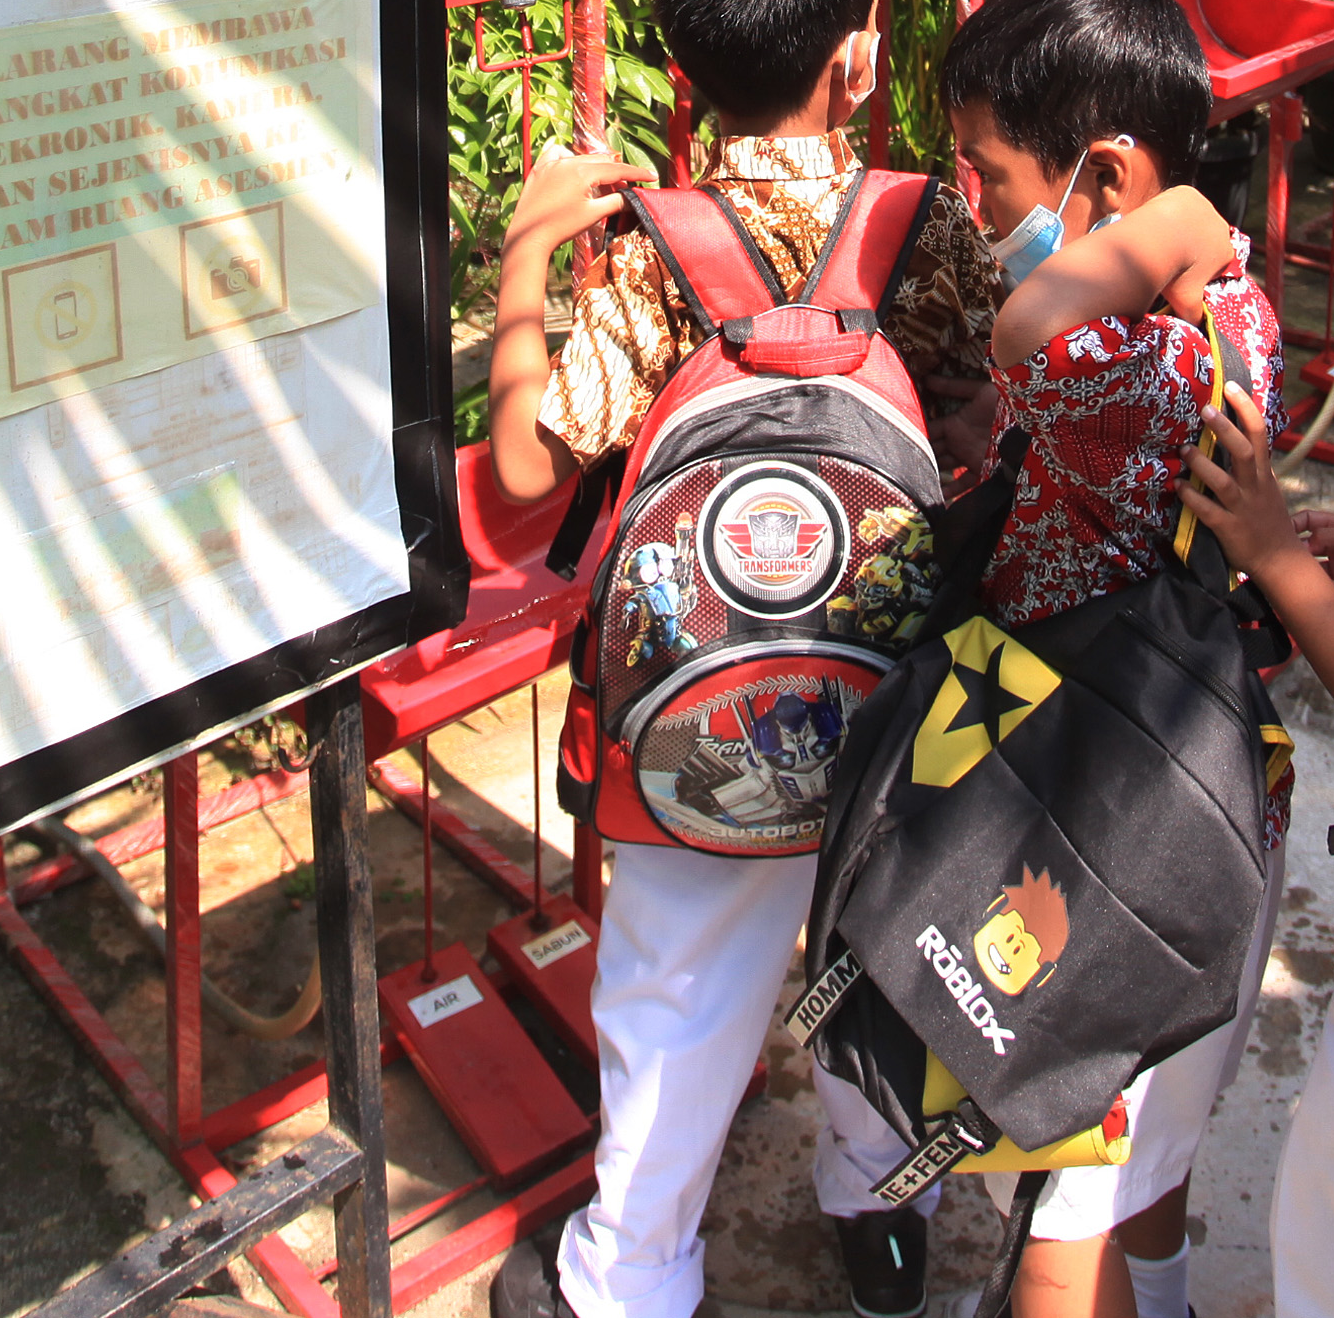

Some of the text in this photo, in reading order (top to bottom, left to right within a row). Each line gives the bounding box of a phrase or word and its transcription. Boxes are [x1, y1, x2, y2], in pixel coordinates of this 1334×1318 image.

[142, 5, 315, 57] MEMBAWA
[138, 37, 348, 97] KOMUNIKASI
[47, 131, 254, 195] SEJENISNYA
[68, 184, 185, 234] RUANG
[738, 560, 813, 573] TRANSFORMERS
[531, 928, 582, 961] SABUN
[433, 991, 461, 1013] AIR
[915, 924, 1016, 1056] ROBLOX
